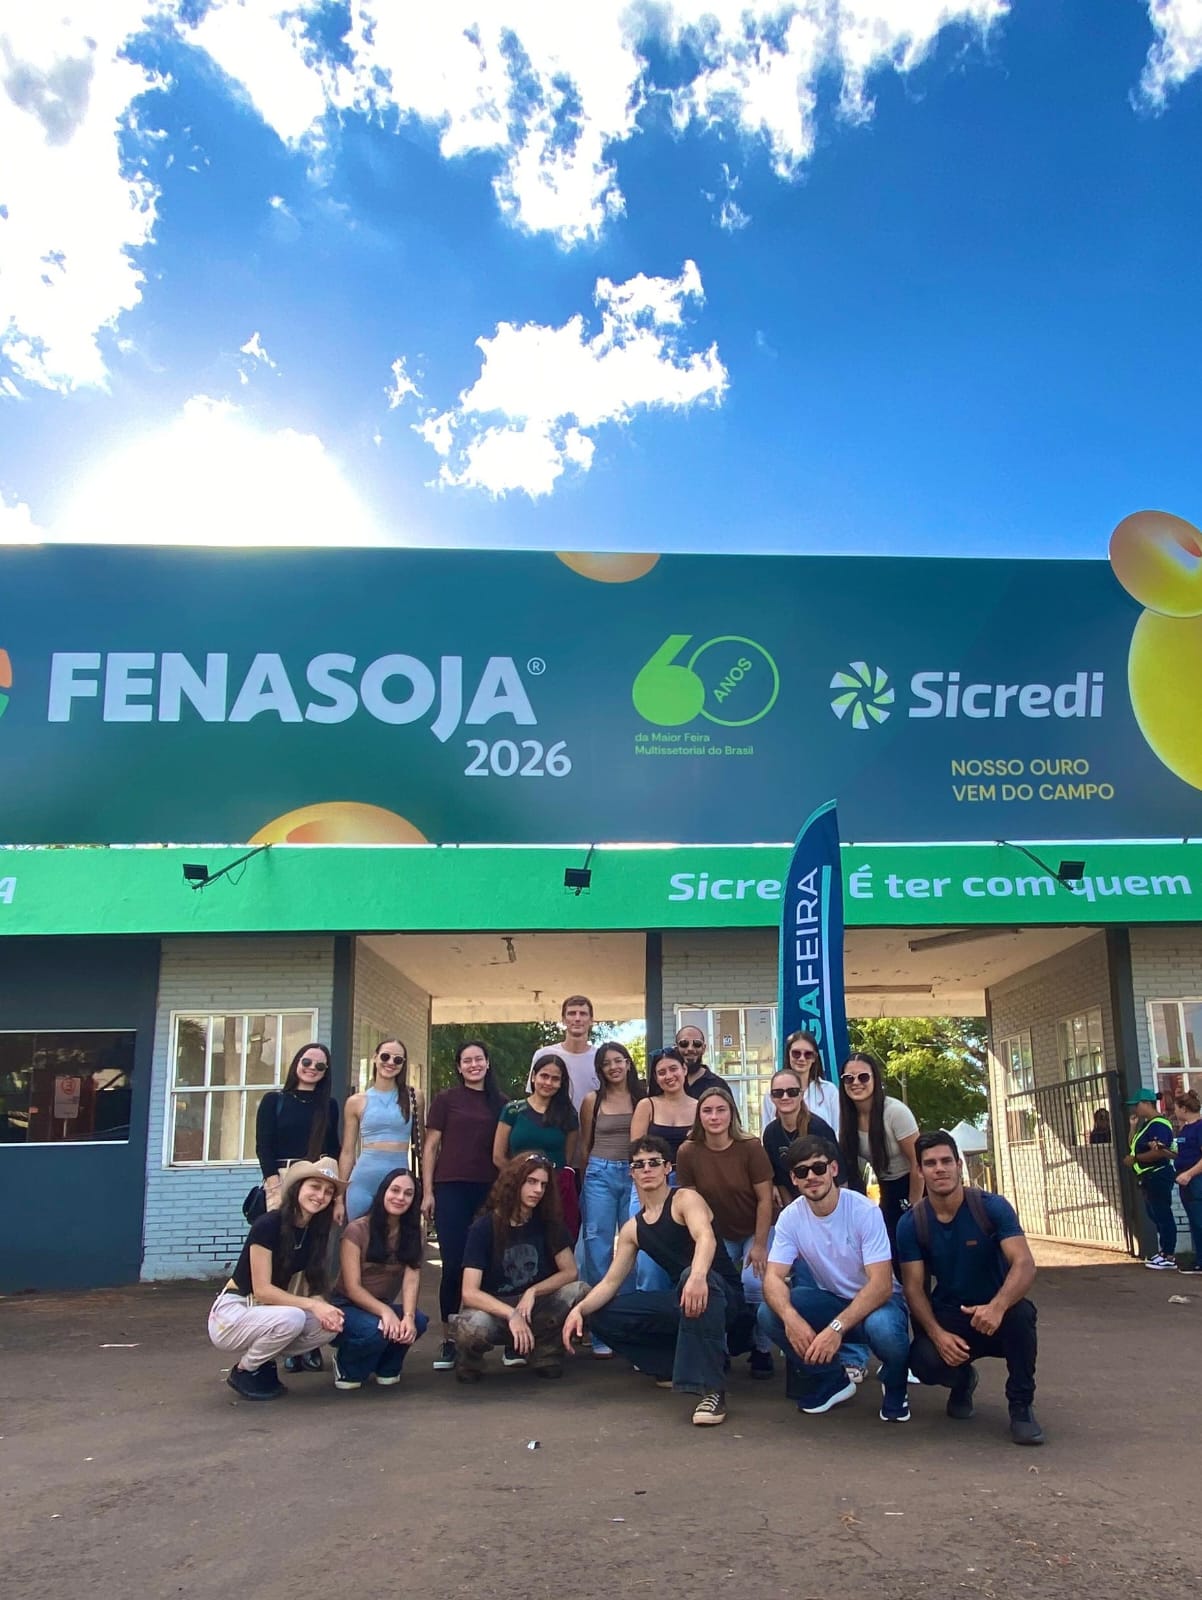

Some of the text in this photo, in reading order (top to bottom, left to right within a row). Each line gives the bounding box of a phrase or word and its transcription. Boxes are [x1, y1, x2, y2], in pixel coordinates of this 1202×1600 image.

[713, 657, 752, 703] ANOS
[908, 671, 1104, 718] Sicredi
[634, 732, 710, 742] da Maior Feira
[634, 745, 753, 755] Multissetorial do Brasil
[464, 739, 572, 777] 2026
[951, 759, 1089, 776] NOSSO OURO
[952, 783, 1114, 801] VEM DO CAMPO
[668, 863, 1192, 902] Sicre É ter com quem
[796, 867, 826, 1072] GAFEIRA
